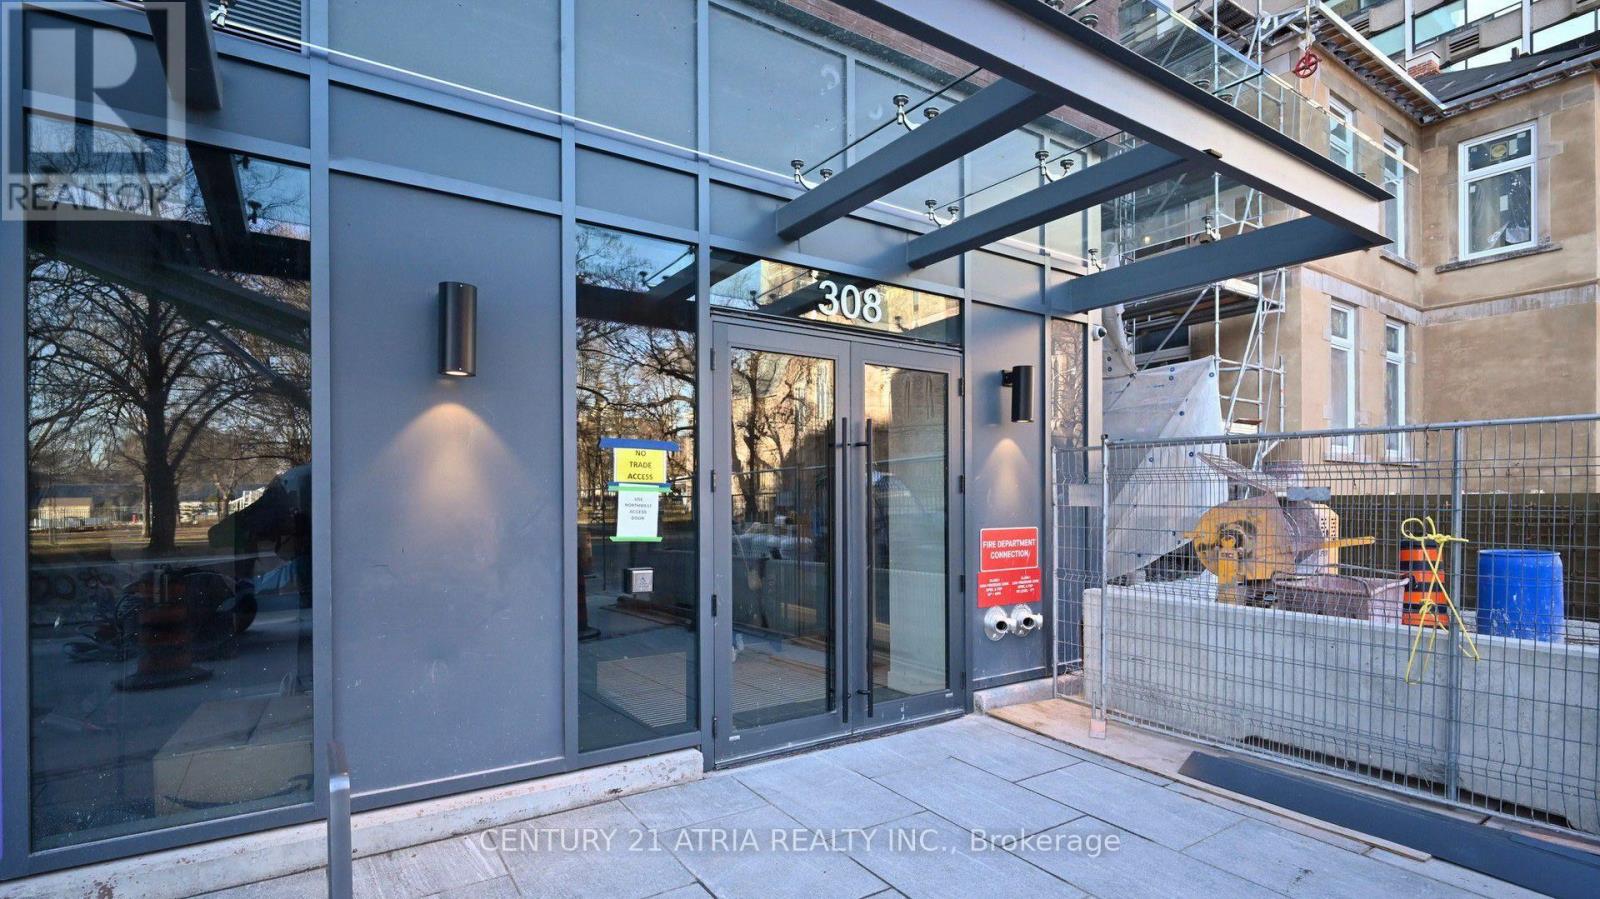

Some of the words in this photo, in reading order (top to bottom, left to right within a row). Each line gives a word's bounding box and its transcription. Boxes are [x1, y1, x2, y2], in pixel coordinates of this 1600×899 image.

[818, 280, 882, 323] 308
[629, 461, 652, 469] TRADE
[998, 539, 1036, 547] DEPARTMENT
[991, 550, 1029, 559] CONNECTION
